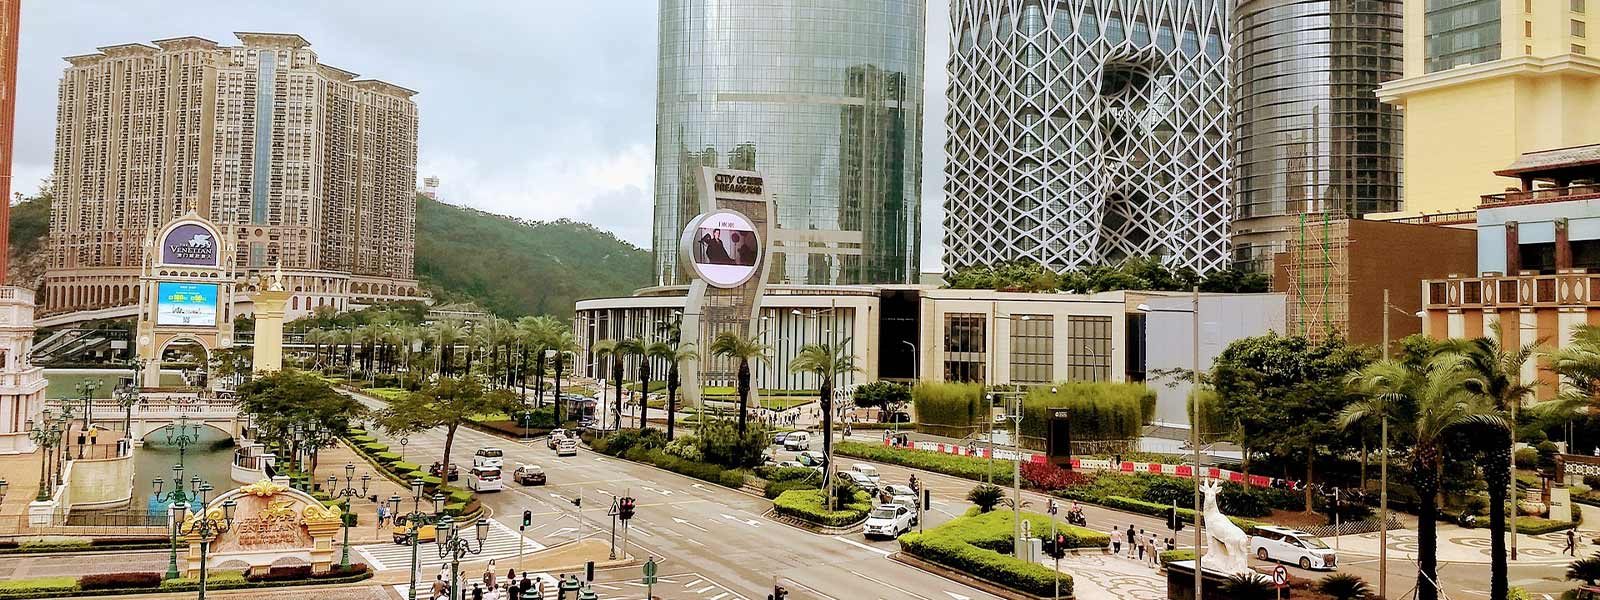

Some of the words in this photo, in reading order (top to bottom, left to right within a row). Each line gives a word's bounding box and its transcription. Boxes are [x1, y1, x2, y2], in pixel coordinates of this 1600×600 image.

[715, 174, 735, 183] CITY
[737, 176, 748, 184] OF
[170, 245, 212, 254] VENETIAN
[231, 522, 297, 535] VENETIAN
